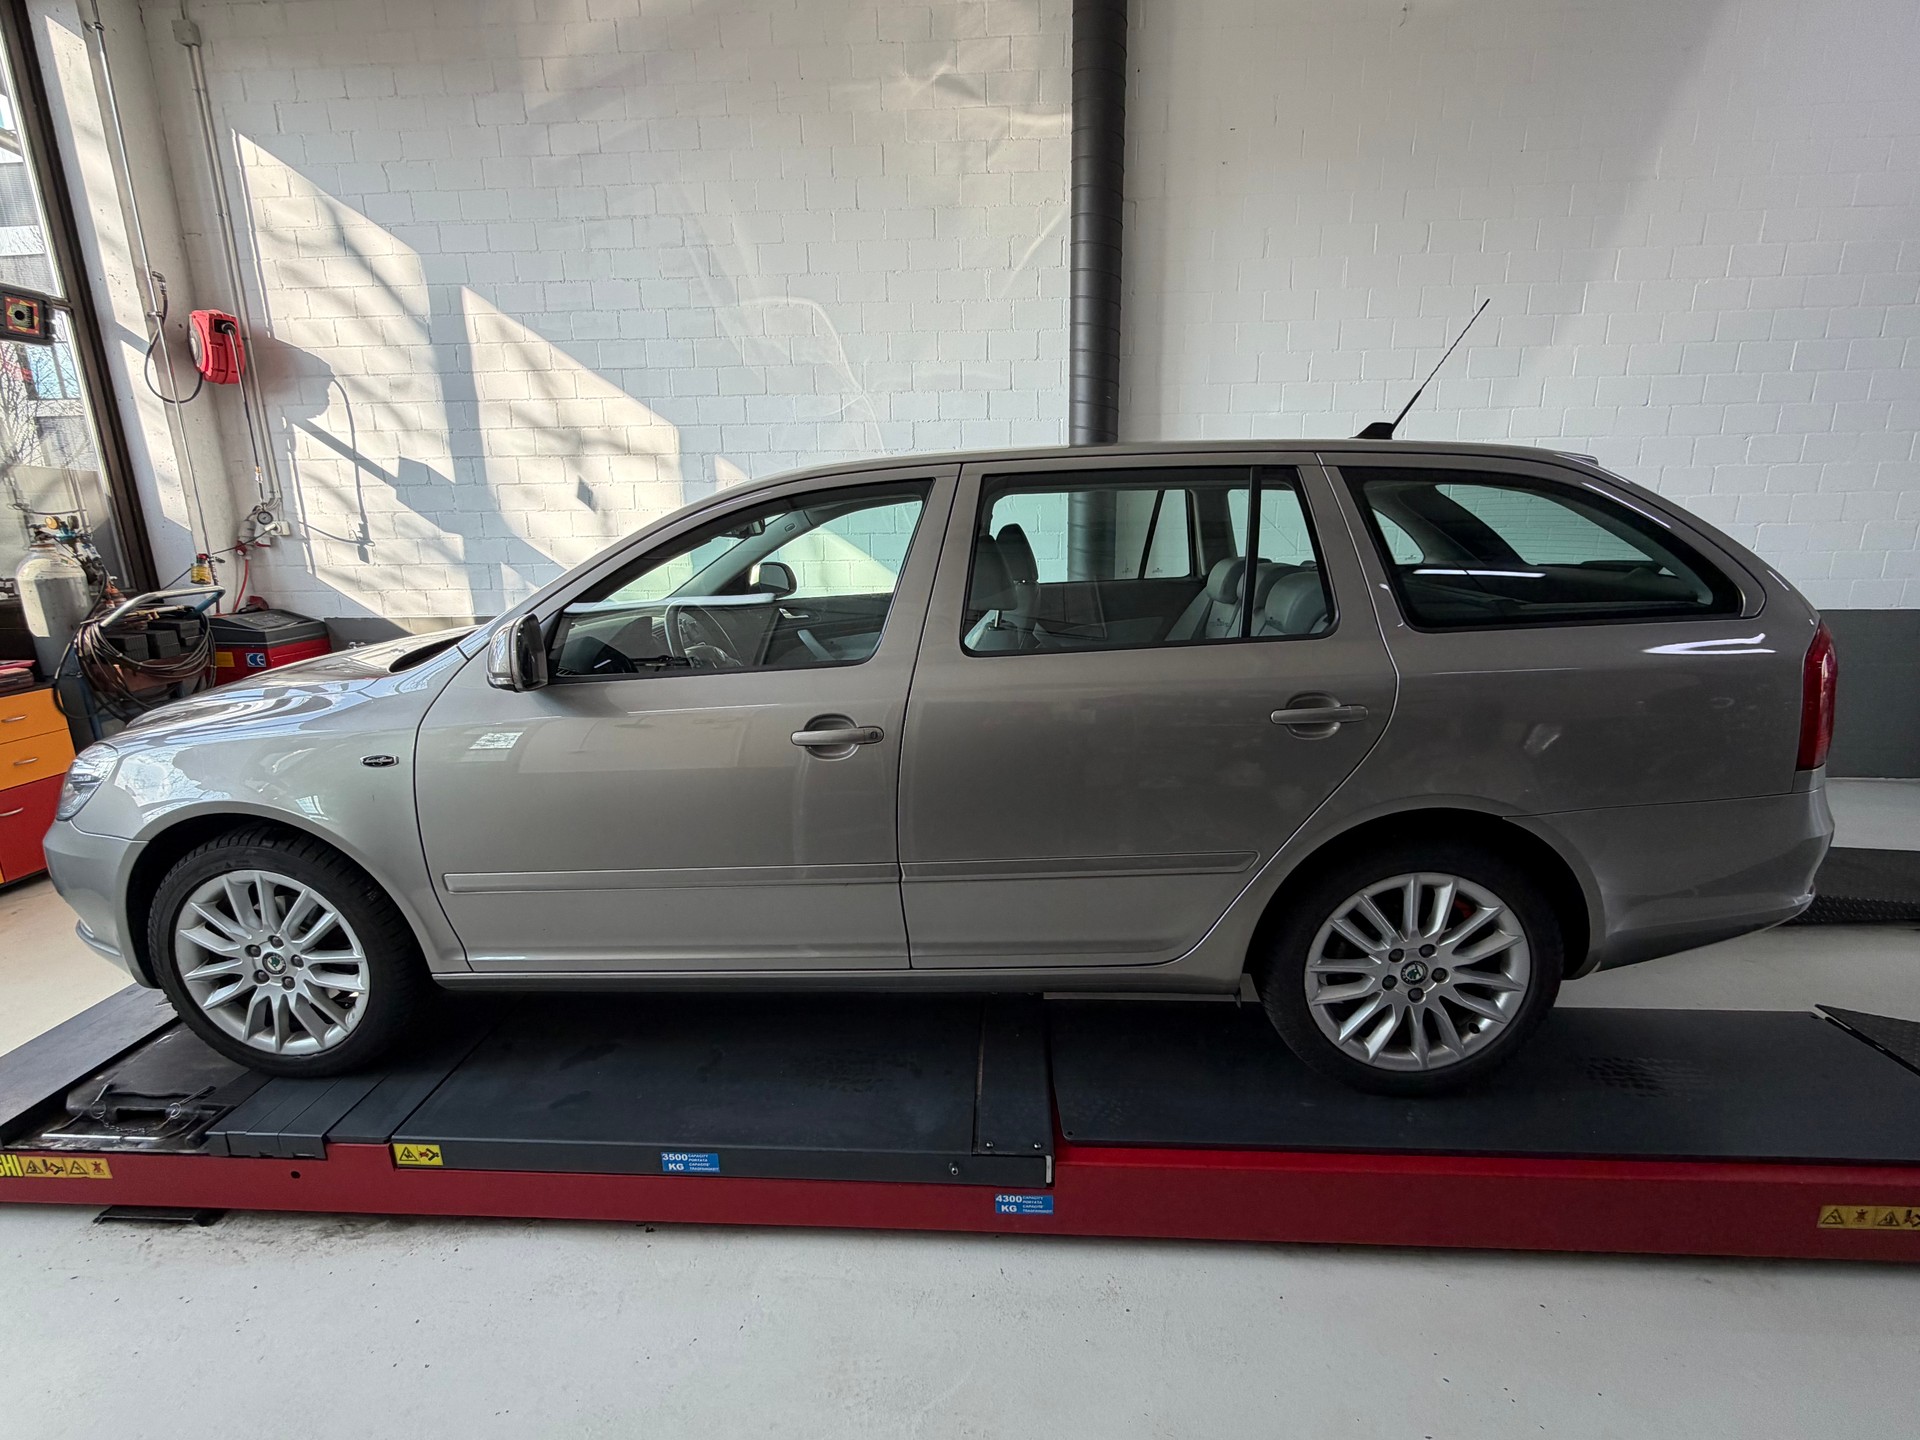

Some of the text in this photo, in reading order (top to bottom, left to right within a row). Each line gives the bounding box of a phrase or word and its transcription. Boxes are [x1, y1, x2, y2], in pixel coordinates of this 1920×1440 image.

[247, 653, 265, 666] CE
[662, 1153, 688, 1161] 3500
[668, 1163, 685, 1171] KG
[996, 1195, 1022, 1203] 4300
[1001, 1205, 1018, 1213] KG
